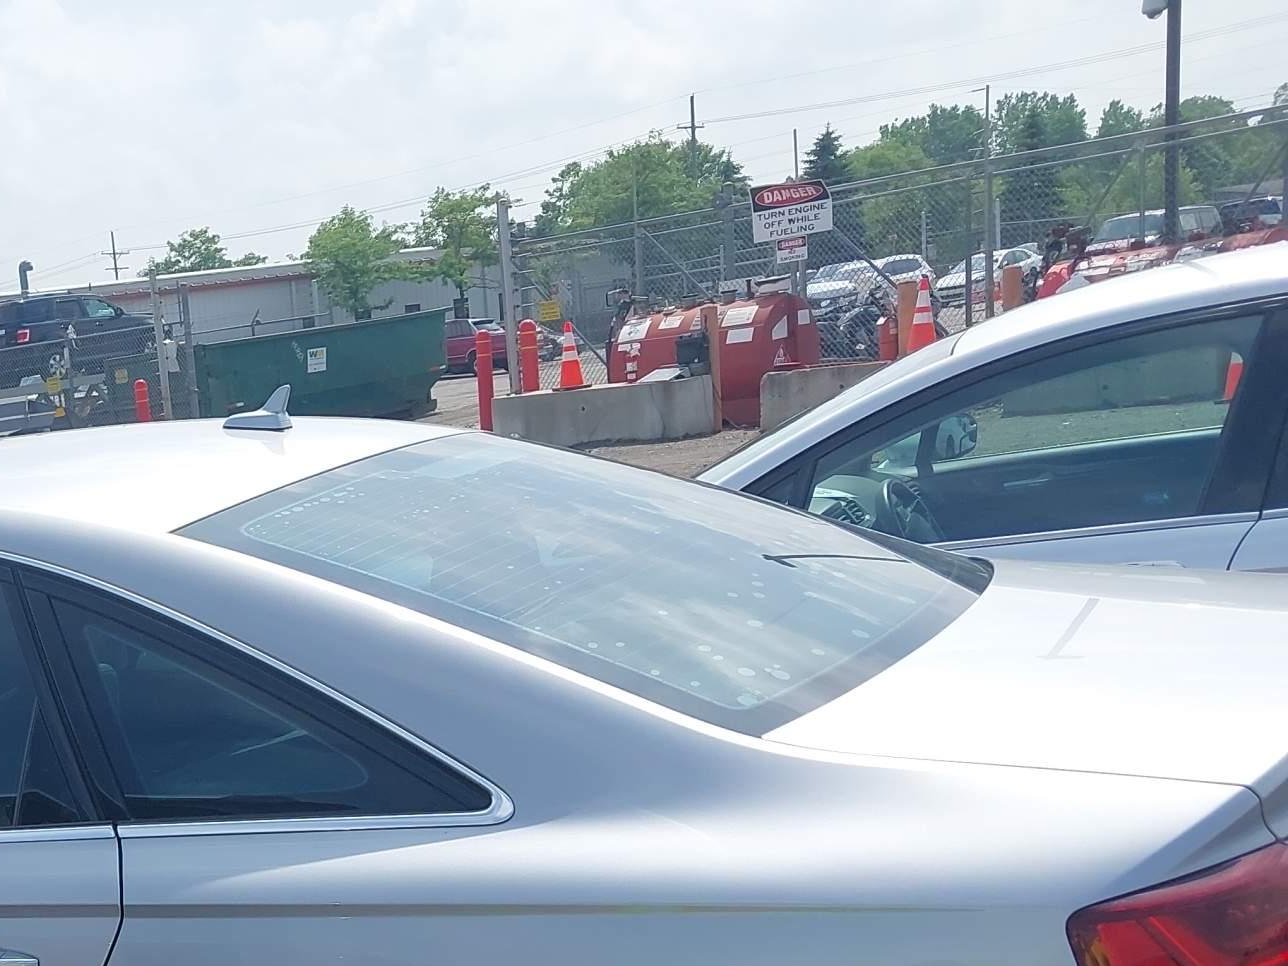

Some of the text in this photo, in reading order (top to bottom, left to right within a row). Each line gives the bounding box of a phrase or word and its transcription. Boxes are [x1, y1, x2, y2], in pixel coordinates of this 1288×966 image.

[763, 187, 816, 203] DANGER
[757, 202, 828, 221] TURN ENGINE
[763, 212, 821, 229] OFF WHILE
[769, 223, 815, 238] FUELING
